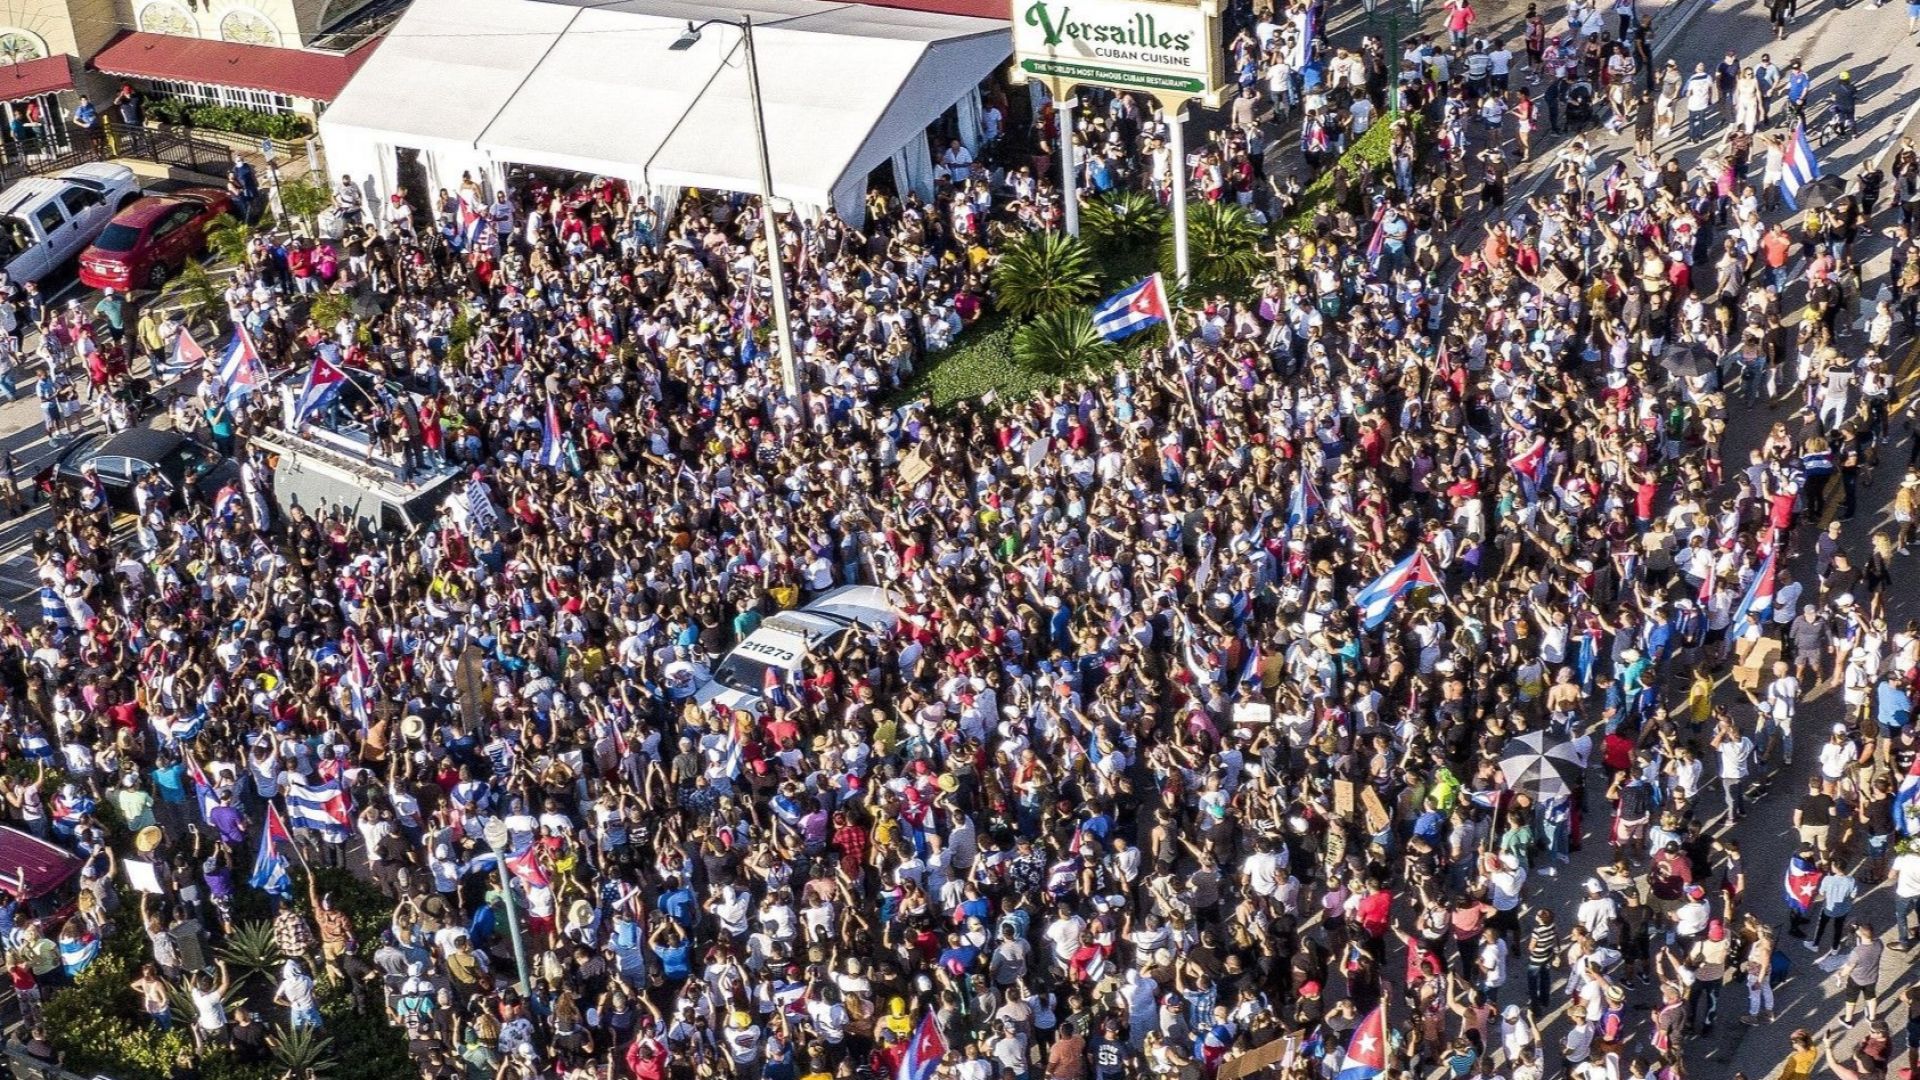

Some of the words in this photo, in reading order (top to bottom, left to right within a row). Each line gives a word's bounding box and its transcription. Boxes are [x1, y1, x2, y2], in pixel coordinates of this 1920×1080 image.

[1025, 1, 1190, 51] Versailles
[1094, 47, 1138, 60] CUBAN
[1140, 52, 1191, 67] CUISINE
[1034, 62, 1046, 71] THE
[1047, 64, 1076, 75] WORLD'S
[1077, 68, 1095, 77] MOST
[1095, 70, 1122, 80] FAMOUS
[1122, 73, 1145, 83] CUBAN
[741, 641, 794, 661] 211273
[1098, 1051, 1118, 1066] 99
